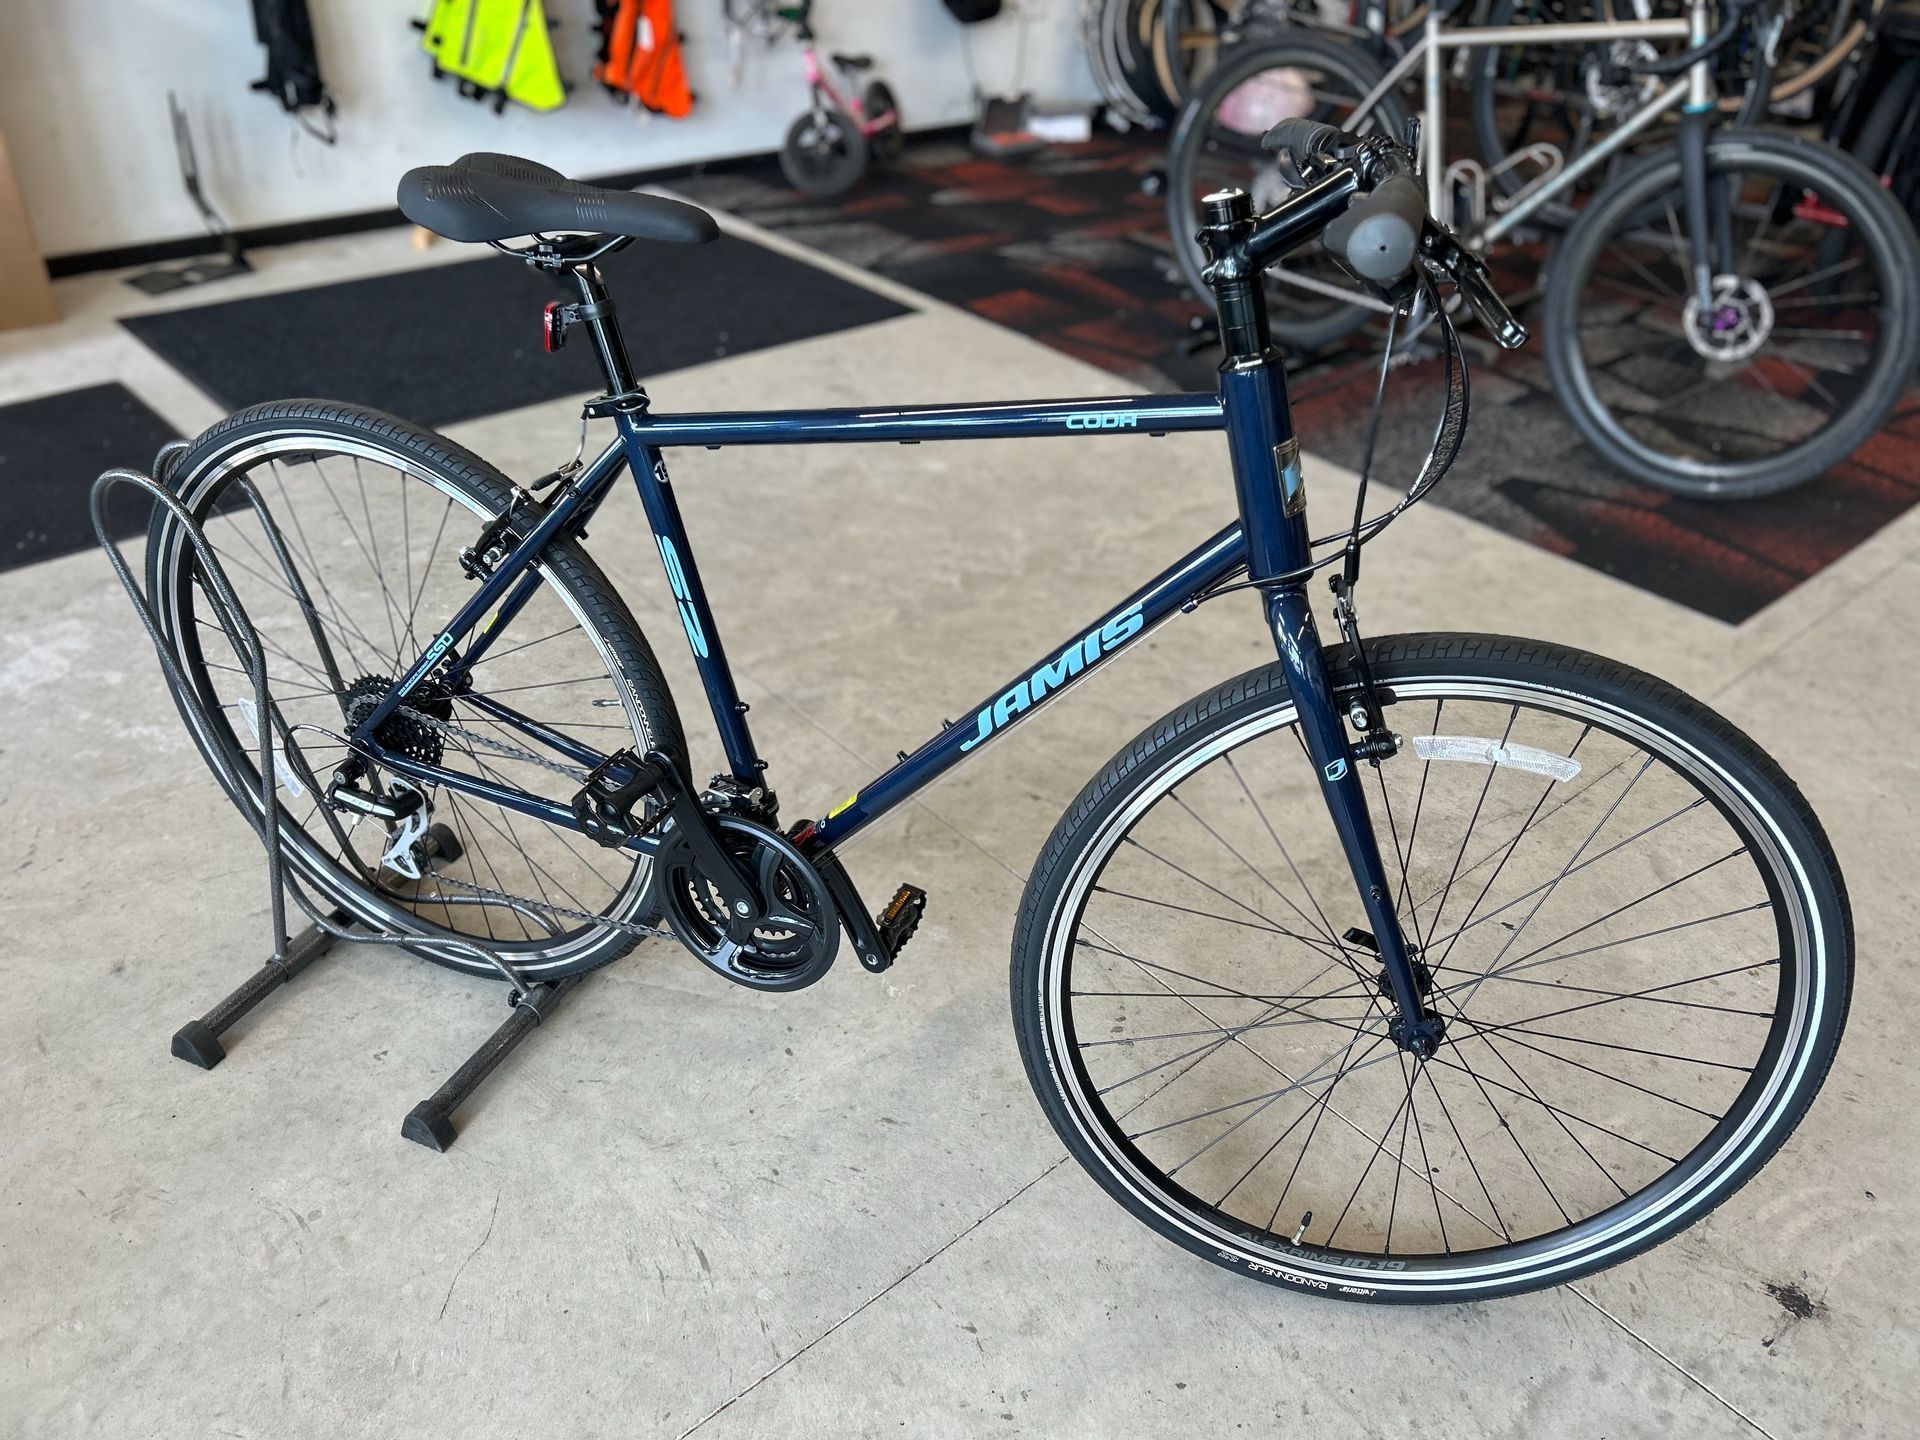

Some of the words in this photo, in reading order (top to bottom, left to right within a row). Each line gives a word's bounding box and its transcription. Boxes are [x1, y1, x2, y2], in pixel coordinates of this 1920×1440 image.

[1066, 413, 1138, 430] CODA
[426, 632, 454, 660] SSD
[959, 602, 1144, 752] JAMIS
[1248, 1261, 1329, 1290] RANDONNEUR
